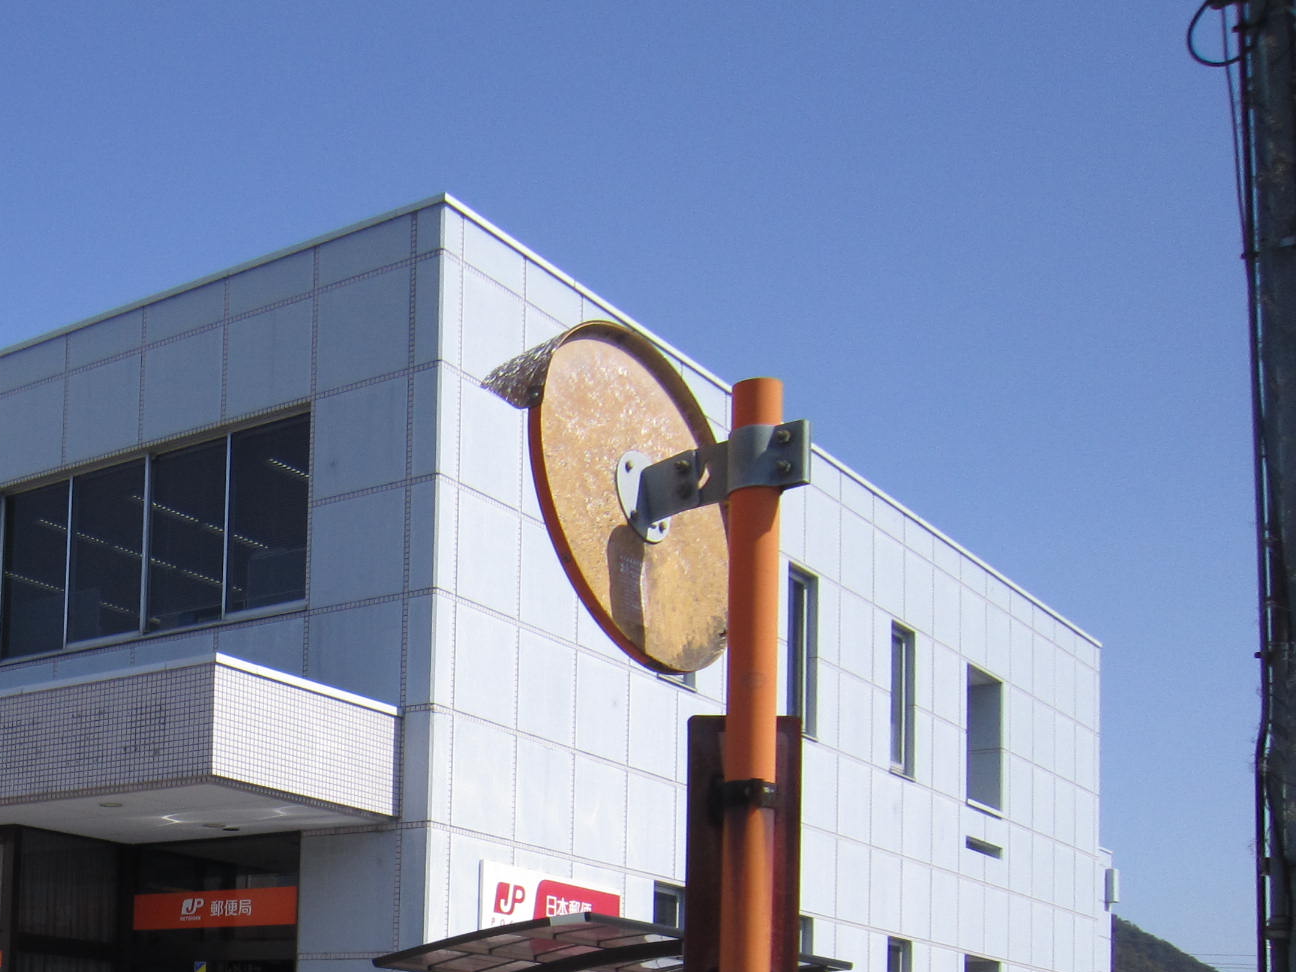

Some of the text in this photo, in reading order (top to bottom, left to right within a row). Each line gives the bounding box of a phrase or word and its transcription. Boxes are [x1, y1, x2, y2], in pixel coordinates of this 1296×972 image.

[181, 898, 252, 917] JP 郵便局
[494, 882, 526, 915] JP
